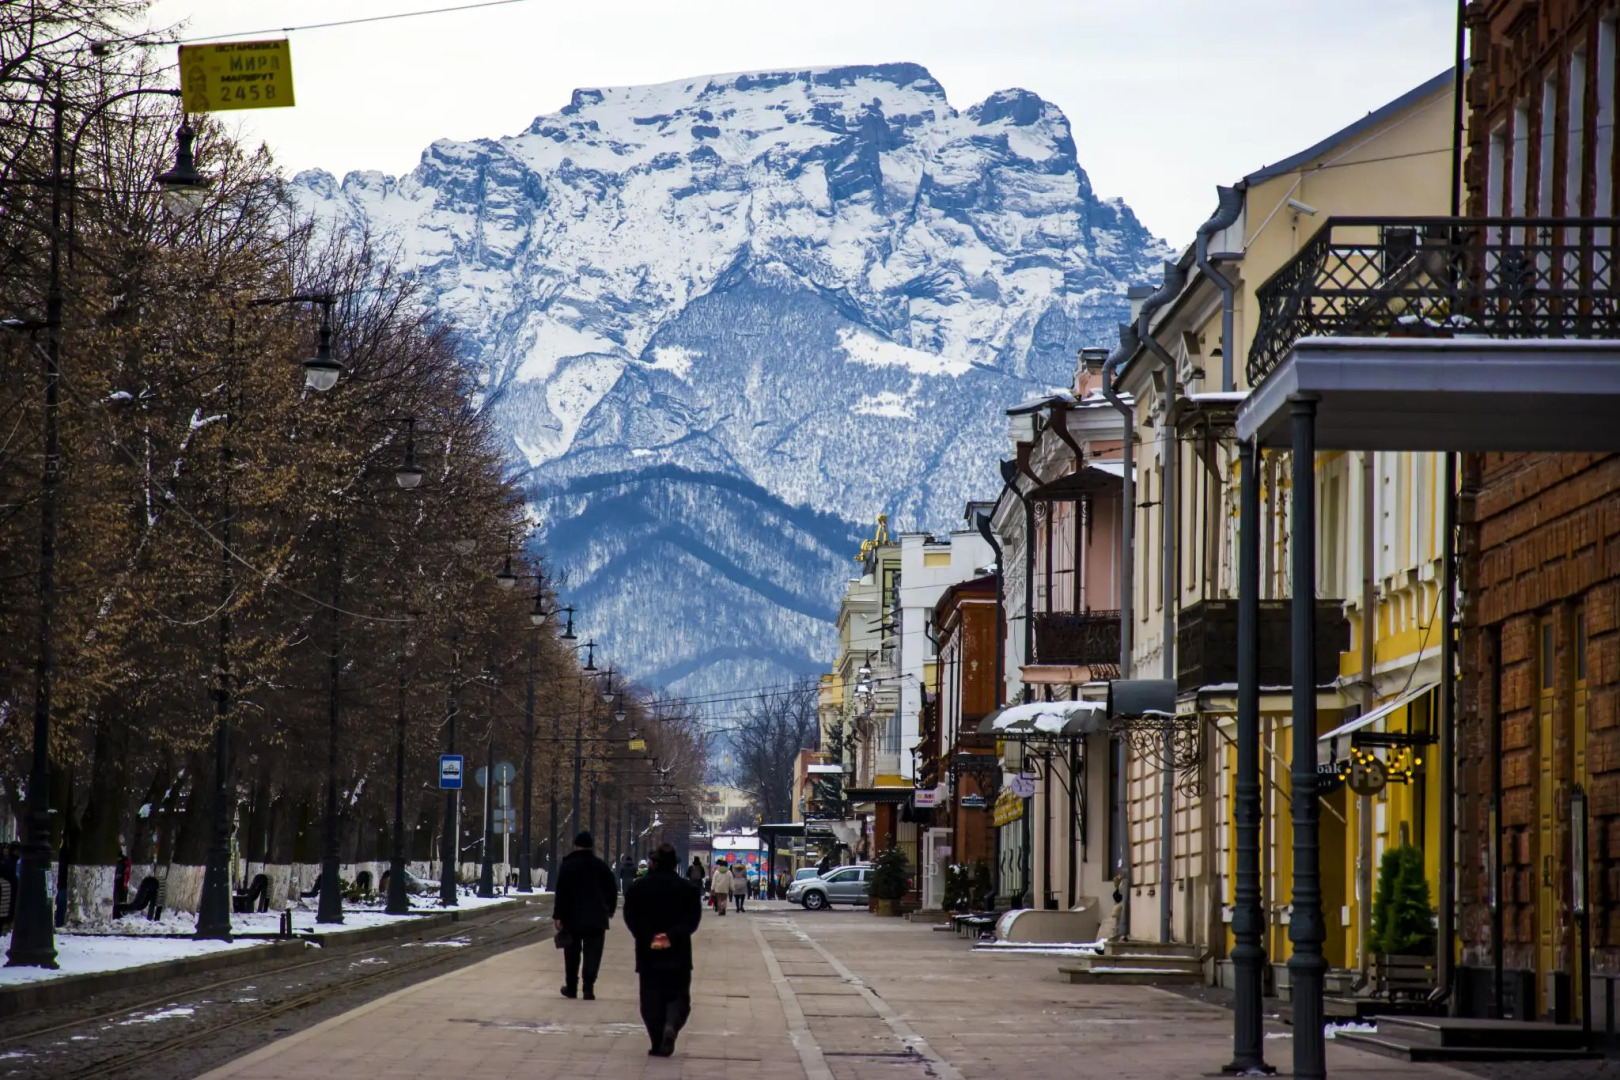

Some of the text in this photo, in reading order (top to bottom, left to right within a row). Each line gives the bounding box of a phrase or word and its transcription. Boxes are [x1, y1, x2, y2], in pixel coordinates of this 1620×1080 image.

[215, 42, 281, 52] ОСТАНОВКА
[221, 73, 275, 82] МАРШРУТ
[1353, 764, 1384, 788] FB
